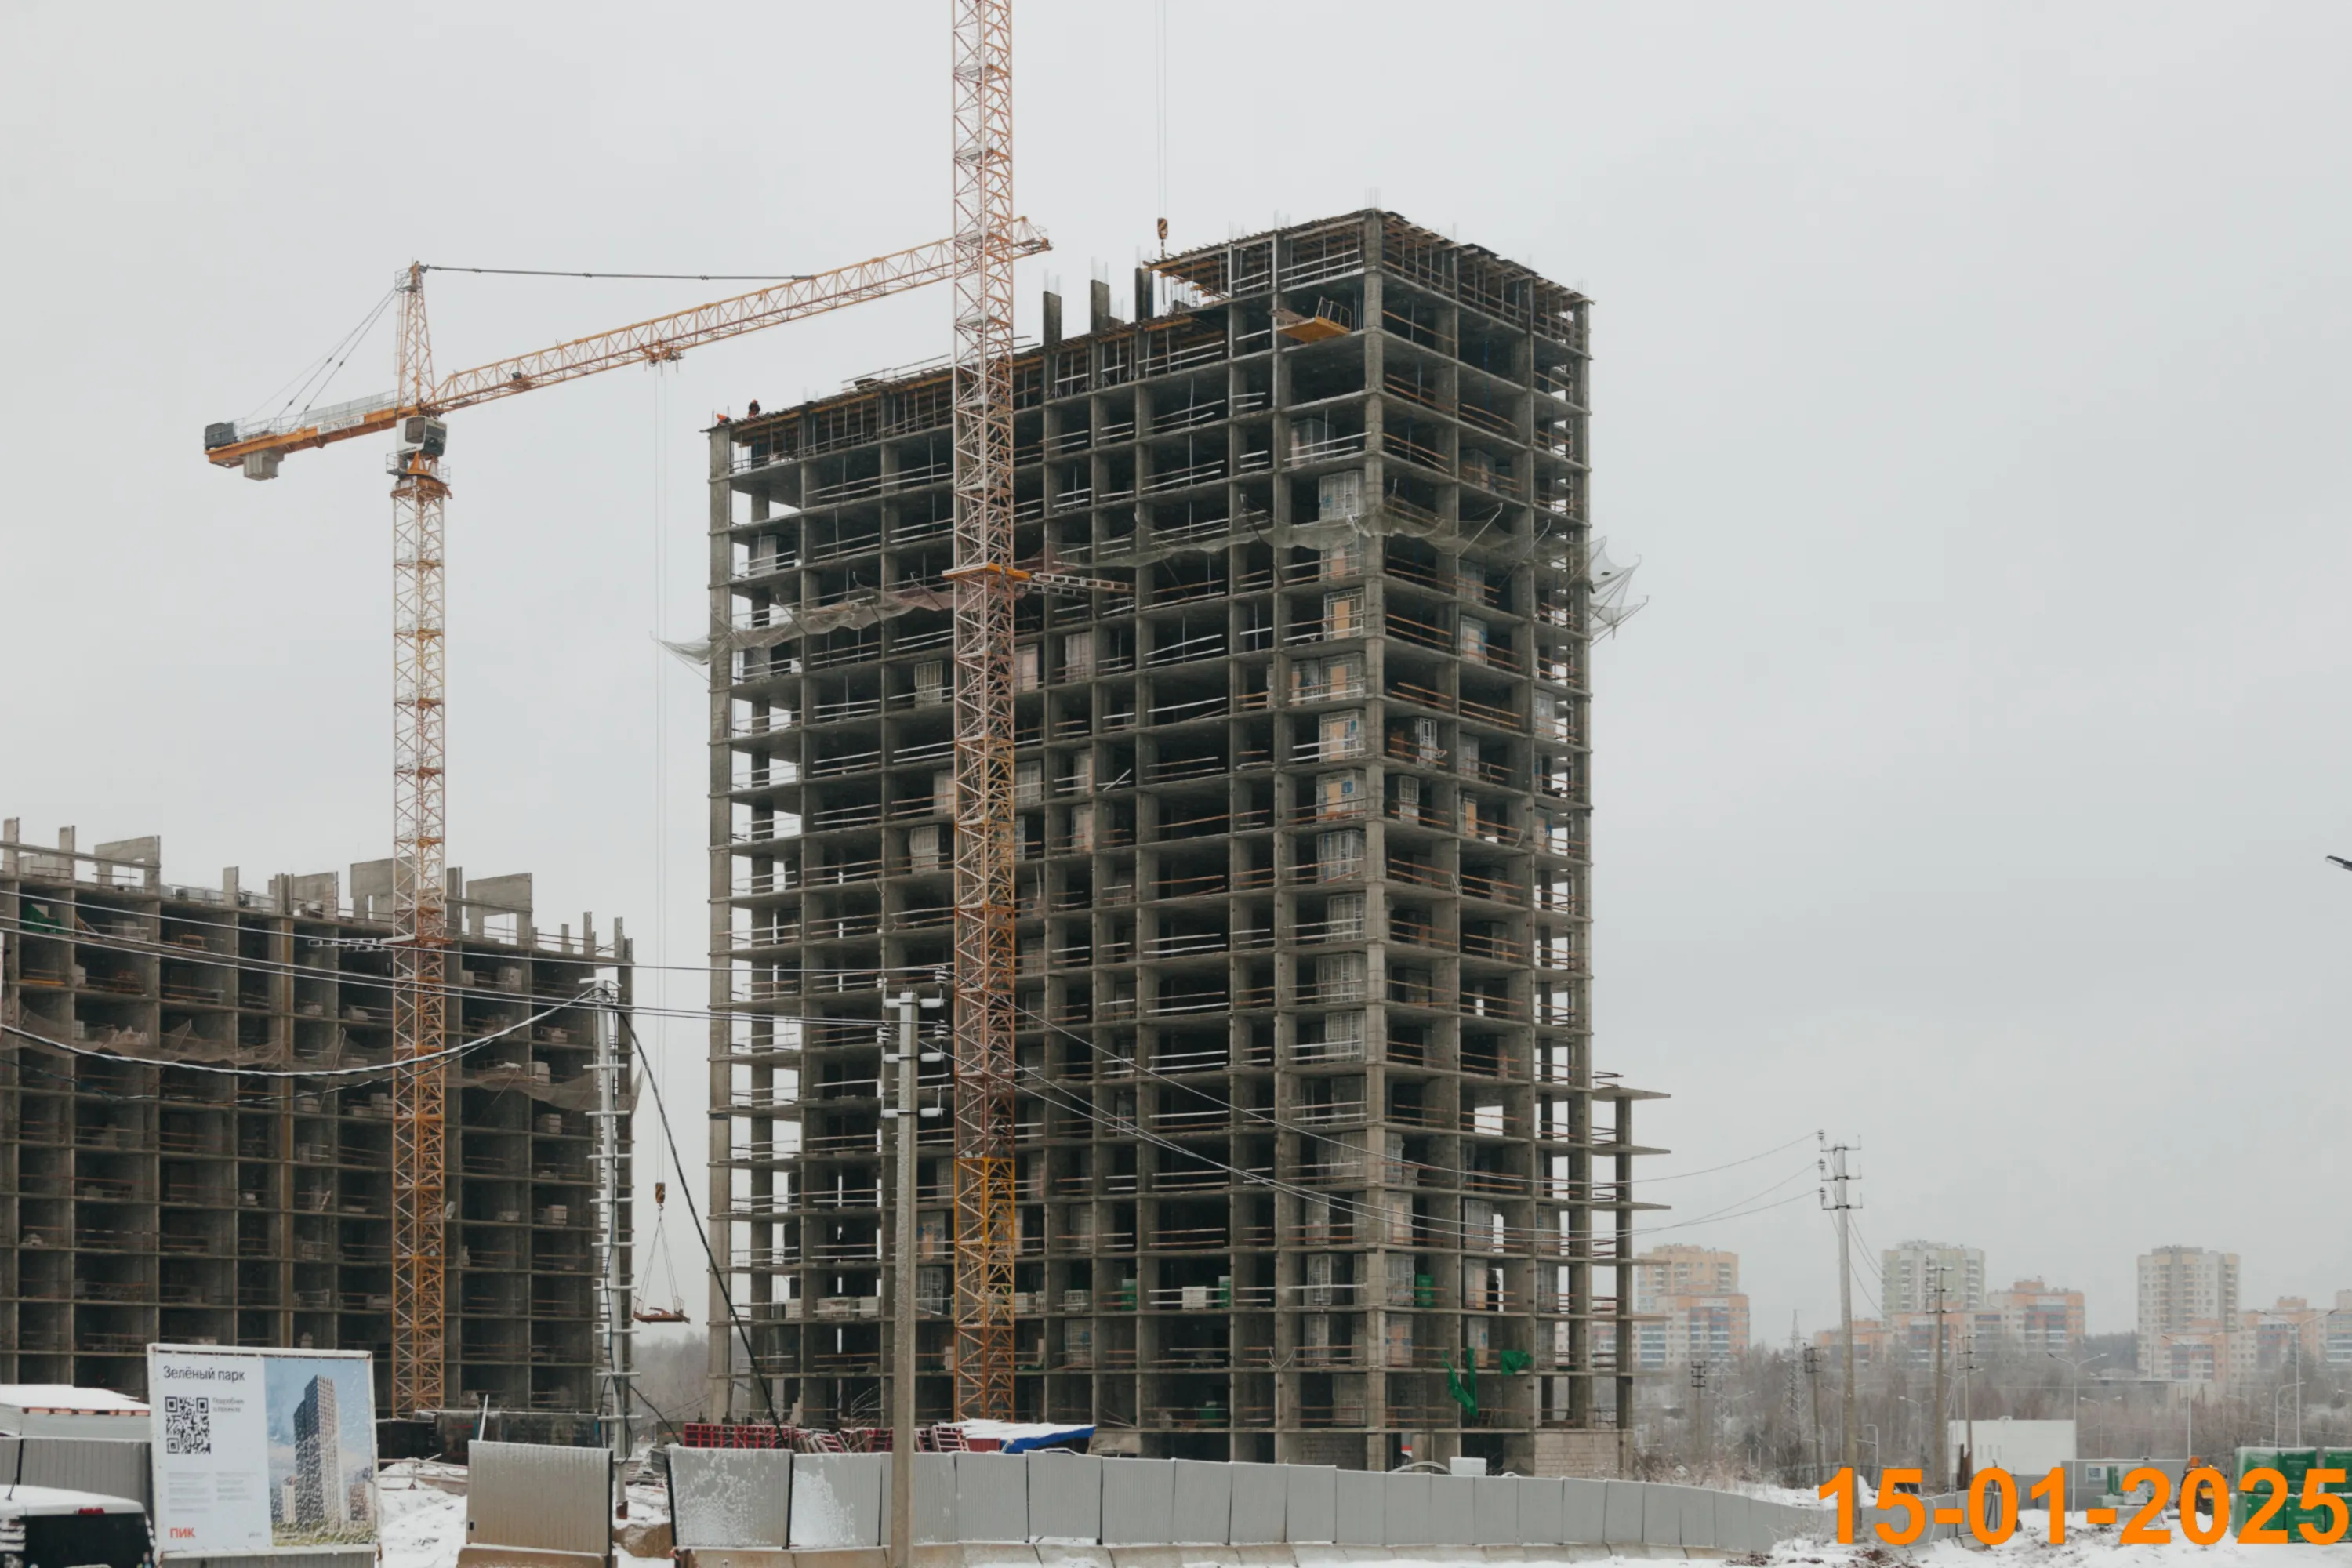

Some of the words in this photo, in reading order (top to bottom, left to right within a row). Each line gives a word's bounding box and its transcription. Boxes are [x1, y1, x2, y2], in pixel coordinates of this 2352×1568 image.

[163, 1365, 216, 1380] Зелёный
[218, 1370, 245, 1383] парк
[170, 1527, 195, 1538] ПИК
